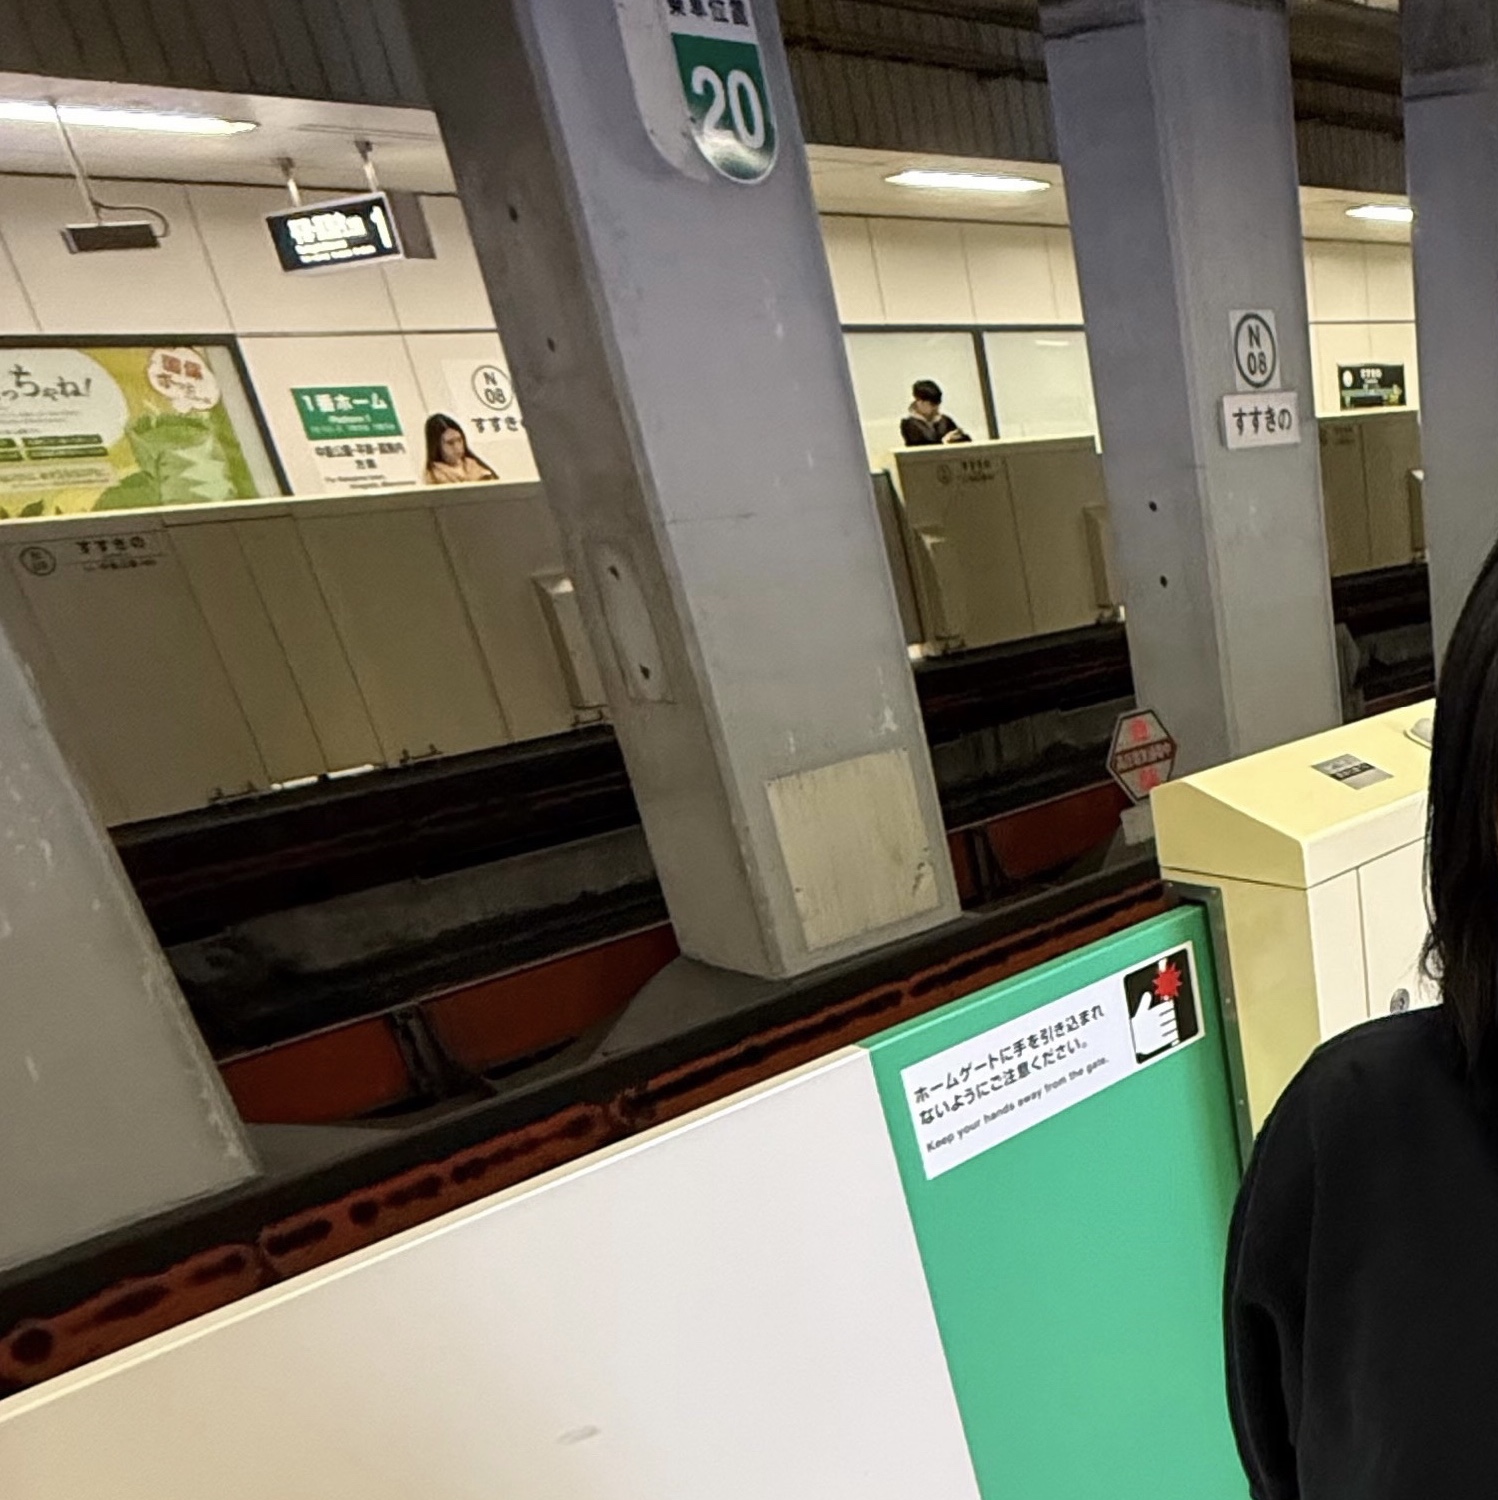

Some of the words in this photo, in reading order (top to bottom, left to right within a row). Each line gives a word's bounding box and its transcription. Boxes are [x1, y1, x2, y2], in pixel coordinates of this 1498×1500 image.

[691, 66, 765, 149] 20
[370, 205, 393, 249] 1
[1247, 324, 1261, 349] N
[1247, 352, 1267, 375] 08
[483, 372, 497, 385] N
[485, 388, 506, 404] 08
[471, 416, 519, 434] すすき
[1232, 406, 1292, 436] すすきの
[914, 1004, 1104, 1103] ホームゲートに手を引き込まれ
[926, 1133, 955, 1152] Keep
[957, 1119, 981, 1139] your
[983, 1103, 1015, 1124] hands
[1017, 1089, 1043, 1107] away
[1044, 1077, 1067, 1092] from
[1068, 1067, 1084, 1080] the
